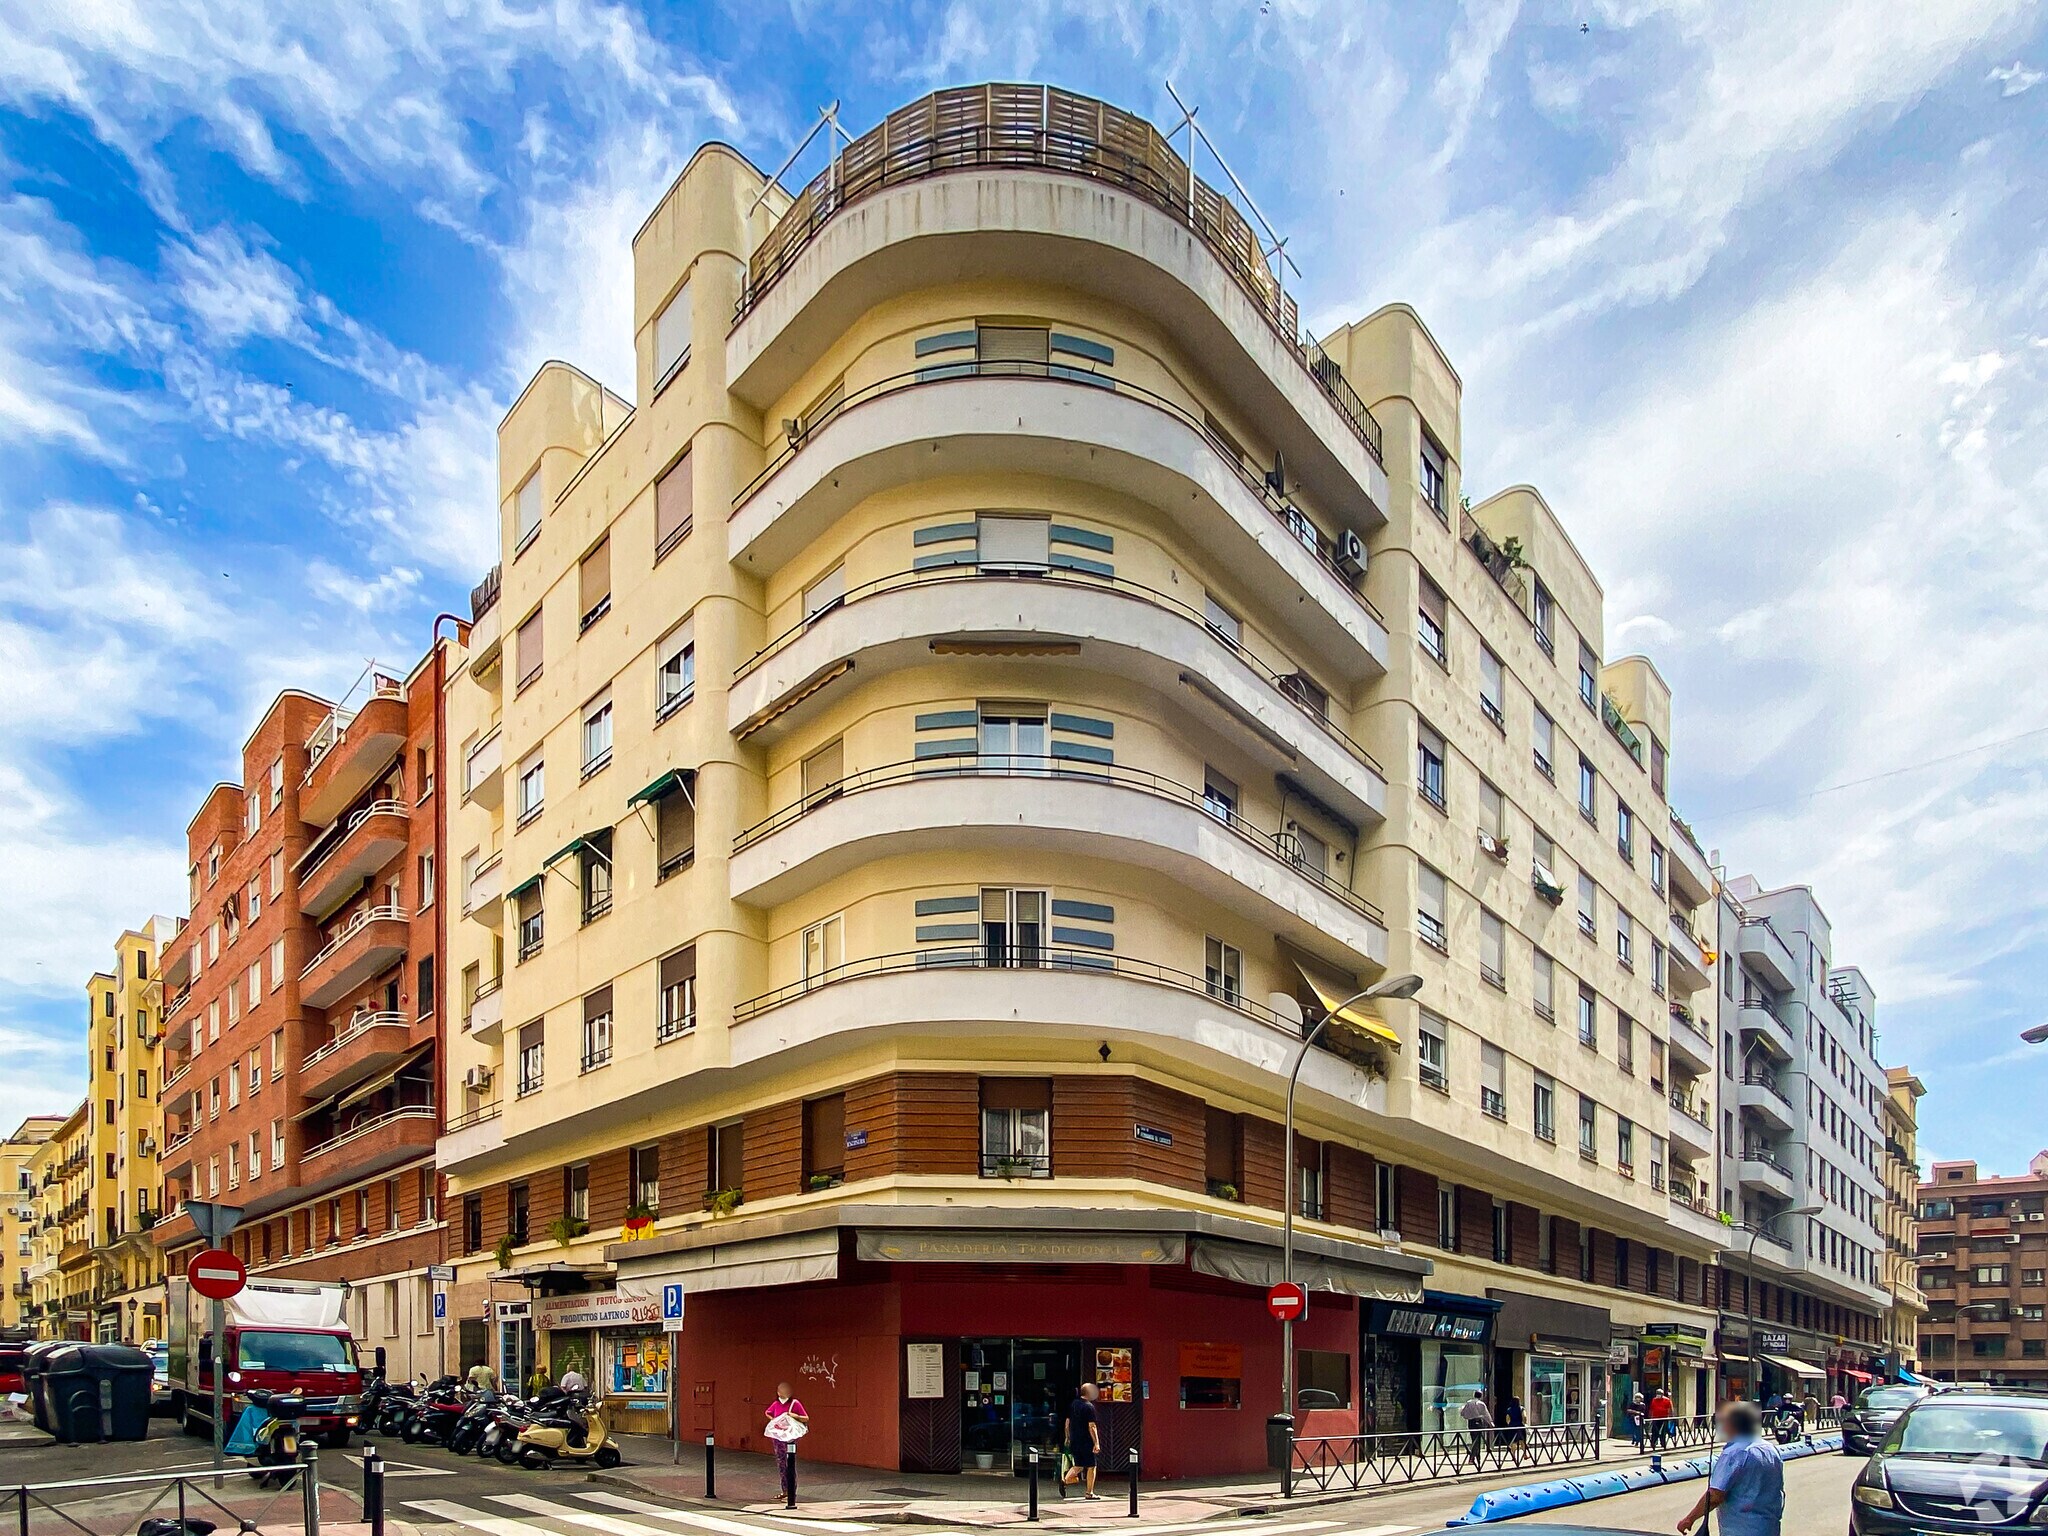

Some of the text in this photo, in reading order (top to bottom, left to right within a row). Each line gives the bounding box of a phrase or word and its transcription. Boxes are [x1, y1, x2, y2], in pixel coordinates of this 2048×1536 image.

[436, 1295, 443, 1316] P
[596, 1296, 623, 1306] FRUTOS
[667, 1287, 677, 1316] P
[560, 1312, 598, 1324] PRODUCTOS
[600, 1310, 630, 1321] LATINOS
[1762, 1334, 1786, 1342] BAZAR
